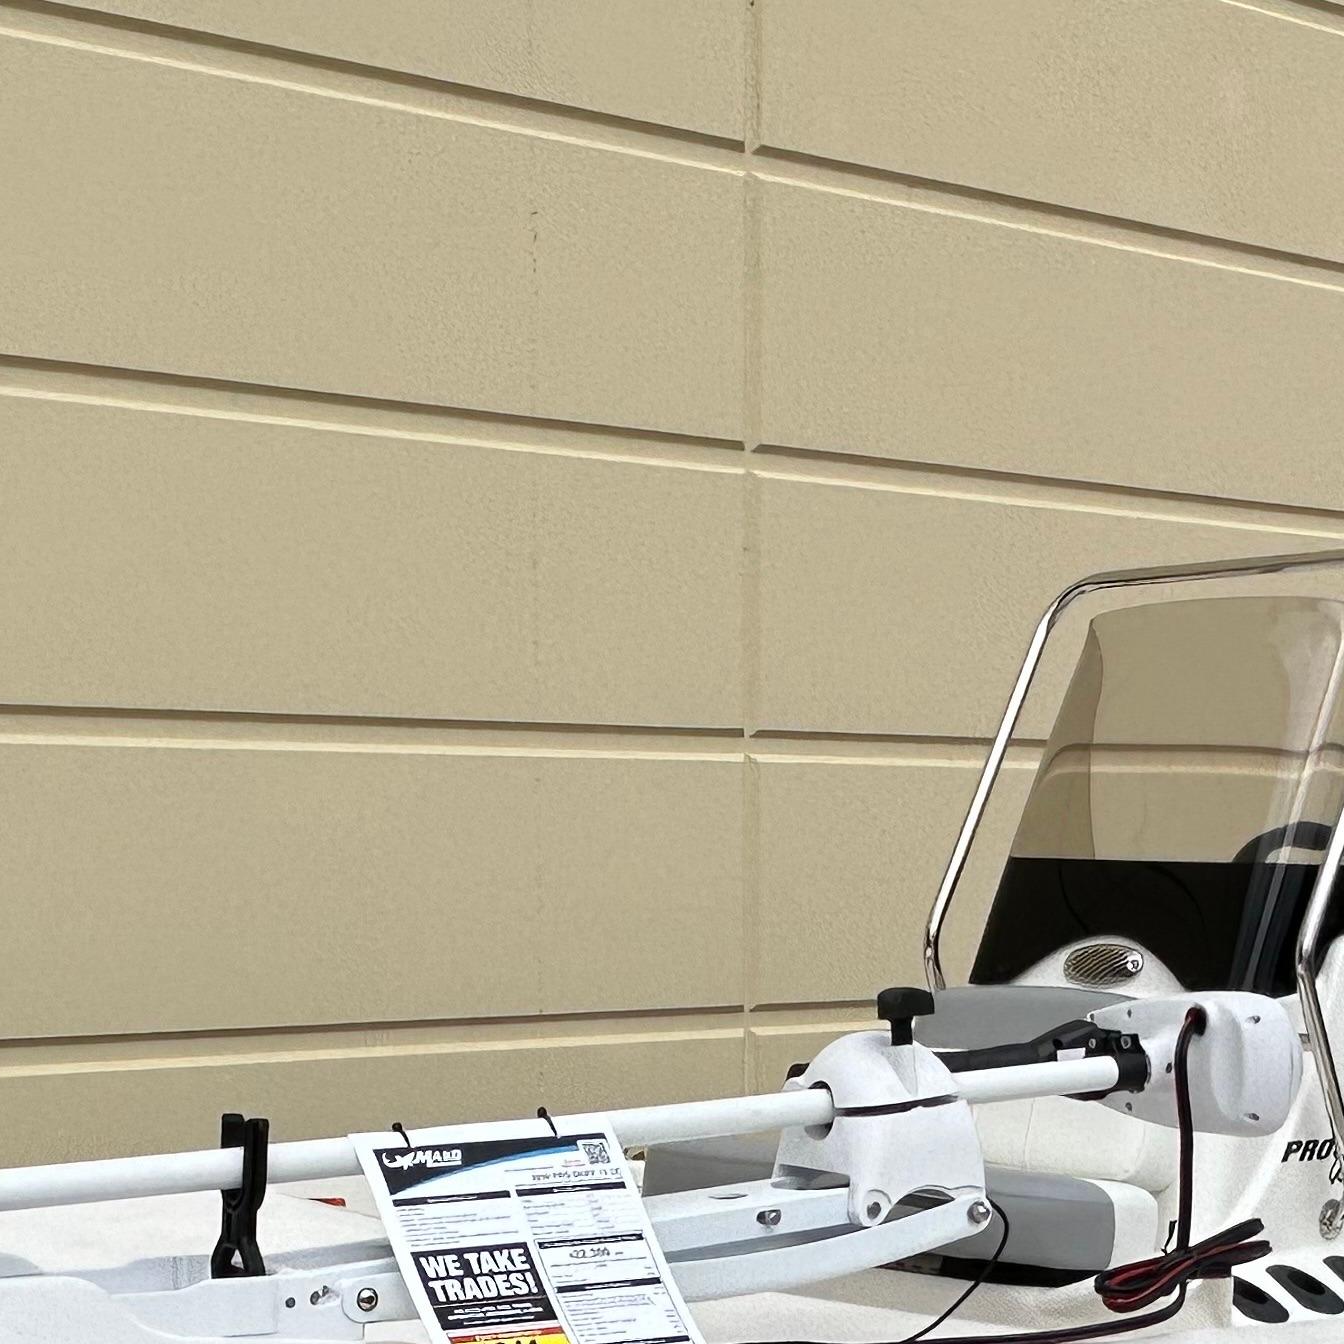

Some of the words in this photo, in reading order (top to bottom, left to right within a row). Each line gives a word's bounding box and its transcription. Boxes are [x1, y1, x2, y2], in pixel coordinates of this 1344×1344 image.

[1281, 1138, 1337, 1163] PRO
[419, 1254, 464, 1278] WE
[464, 1248, 531, 1275] TAKE
[428, 1271, 539, 1302] TRADES!
